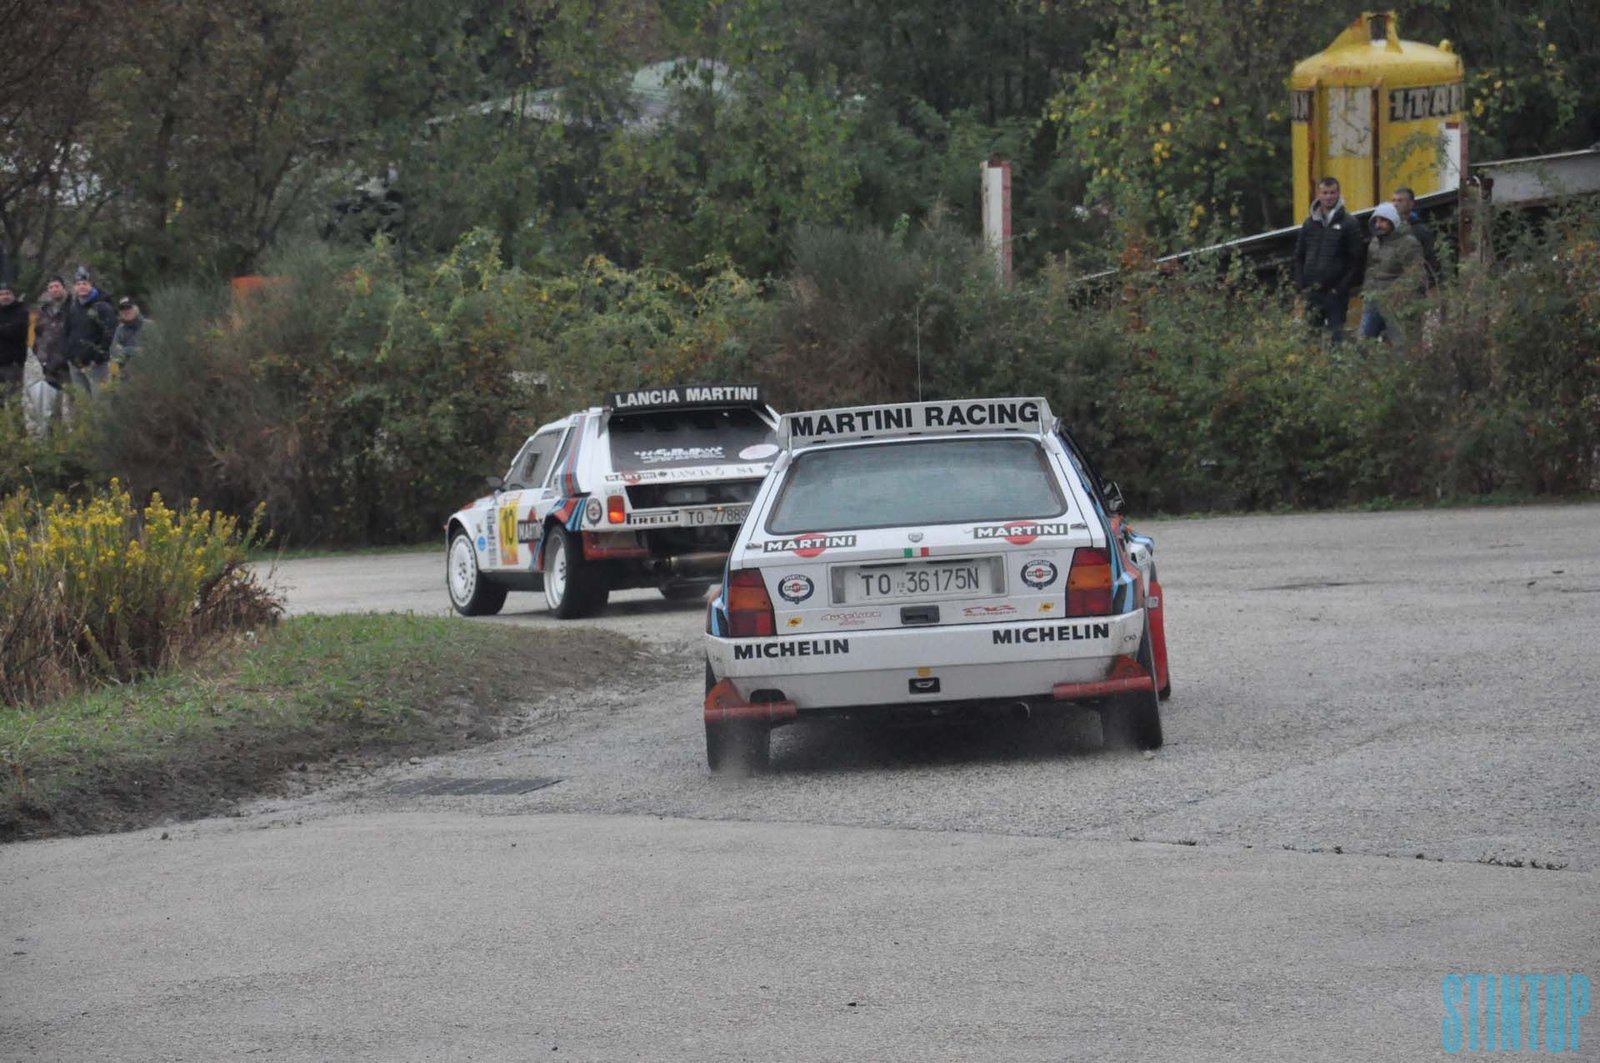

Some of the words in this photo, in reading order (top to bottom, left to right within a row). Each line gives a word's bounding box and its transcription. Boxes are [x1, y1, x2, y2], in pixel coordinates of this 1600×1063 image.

[615, 389, 679, 408] LANCIA
[686, 387, 758, 402] MARTINI
[790, 407, 913, 437] MARTINI
[925, 402, 1039, 427] RACING
[627, 509, 678, 525] PIRELLI
[688, 511, 704, 524] TO
[977, 523, 1065, 538] MARTINI
[767, 535, 854, 552] MARTINI
[861, 574, 891, 596] TO
[905, 567, 980, 593] 36175N
[992, 623, 1110, 645] MICHELIN
[734, 639, 849, 660] MICHELIN
